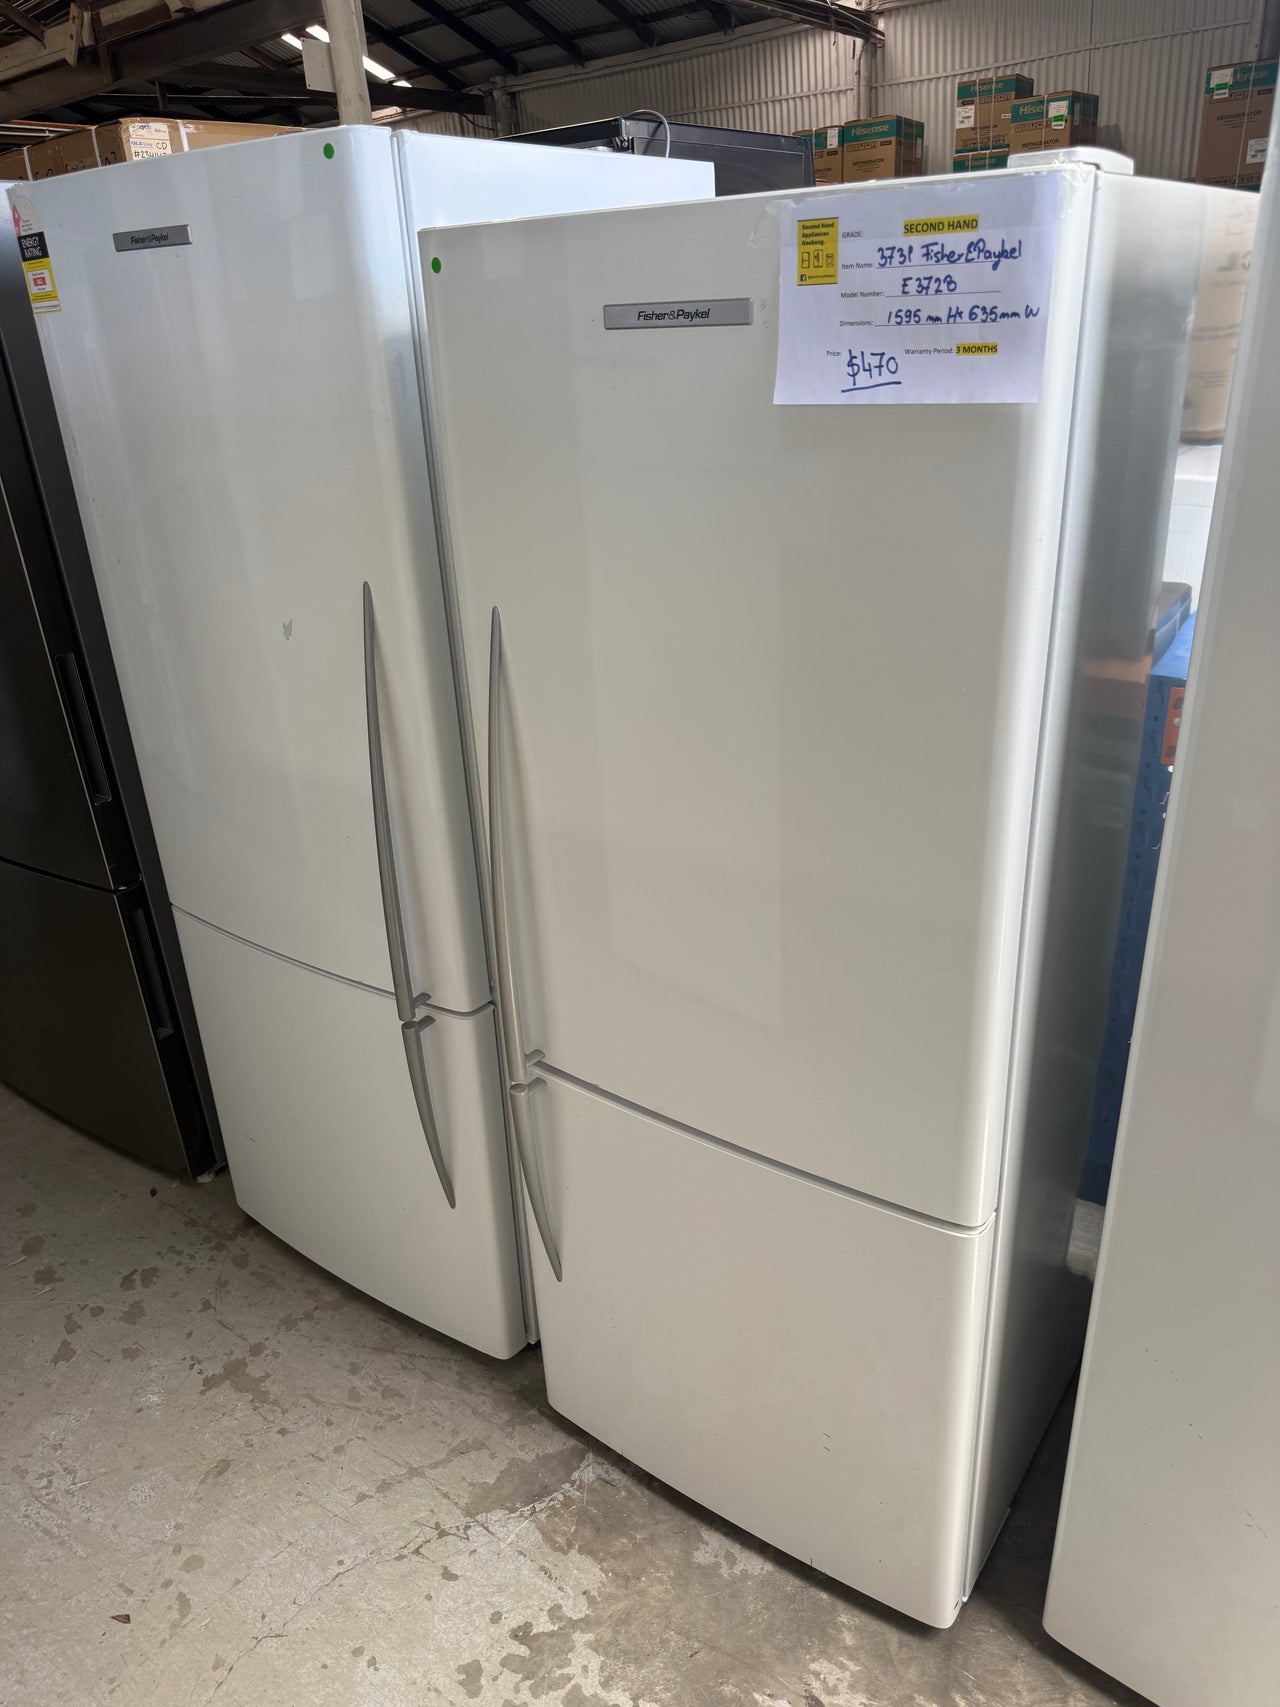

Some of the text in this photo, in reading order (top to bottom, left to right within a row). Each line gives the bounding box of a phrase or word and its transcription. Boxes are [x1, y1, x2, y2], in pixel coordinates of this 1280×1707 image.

[970, 82, 1004, 93] Hisense
[851, 123, 889, 136] Hisense
[1021, 139, 1060, 148] REFRIGERATOR
[903, 218, 979, 234] SECOND HAND
[801, 231, 829, 239] Appliances
[841, 230, 864, 239] GRADE:
[21, 235, 40, 249] ENERGY
[24, 245, 43, 258] RATING
[859, 290, 884, 298] Number:
[637, 307, 711, 322] Fisher&Paykel
[839, 319, 874, 328] Dimensions:
[887, 308, 921, 325] 1595
[955, 346, 961, 354] 3
[962, 345, 998, 354] MONTHS
[846, 348, 899, 386] $470
